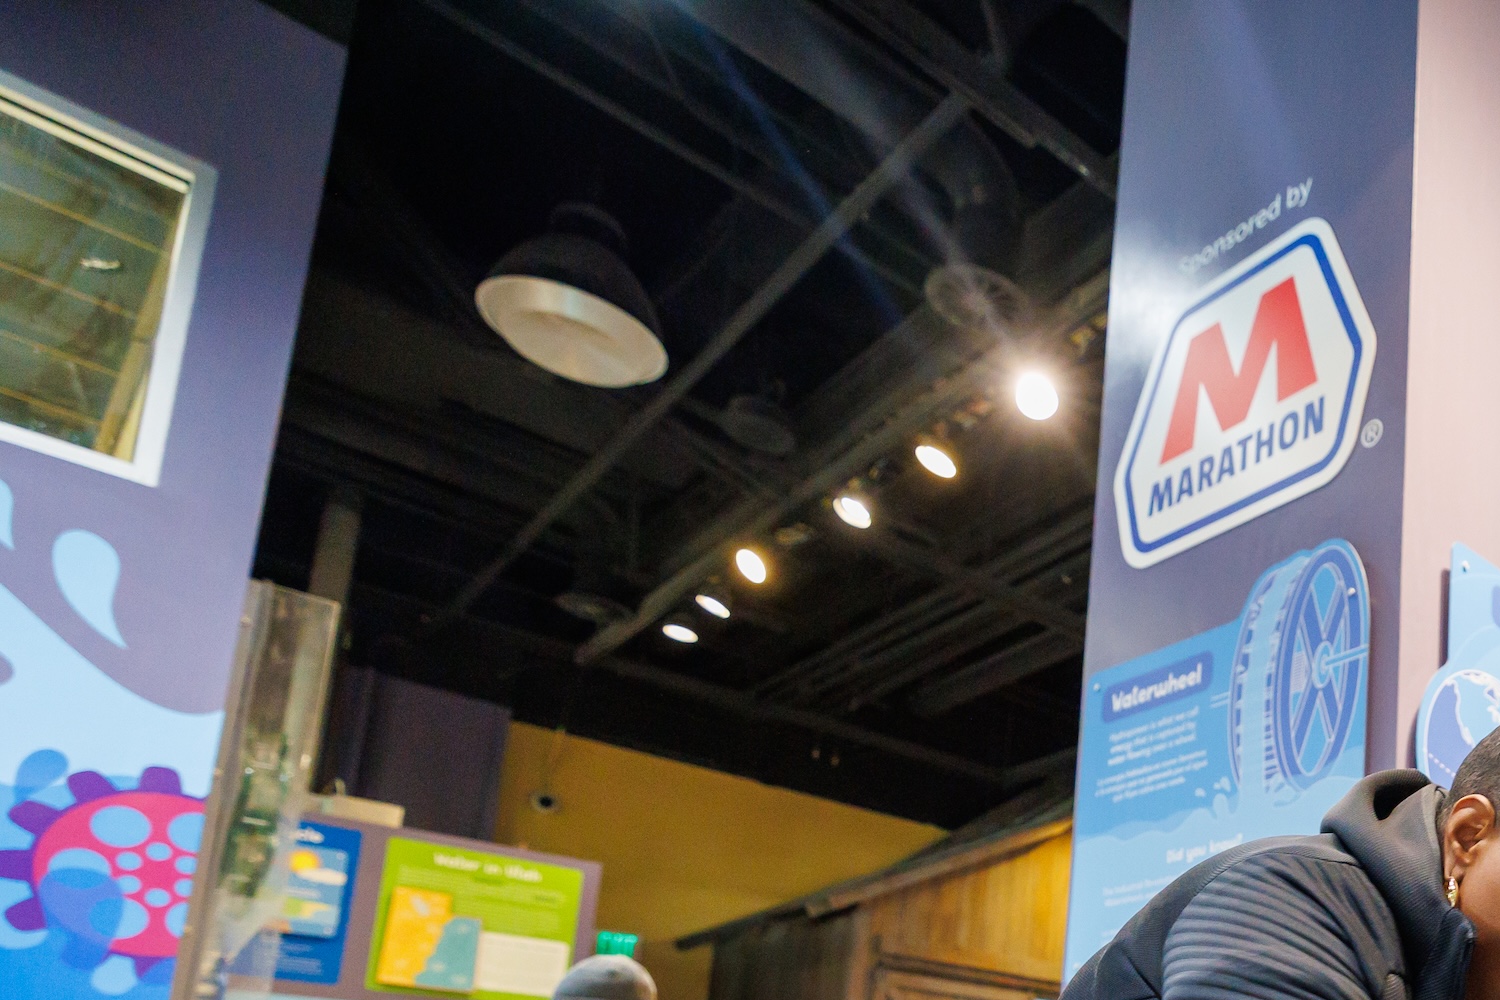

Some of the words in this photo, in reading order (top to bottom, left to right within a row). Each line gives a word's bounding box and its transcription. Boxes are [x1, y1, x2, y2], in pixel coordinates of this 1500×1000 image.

[1286, 177, 1313, 209] by
[1159, 275, 1318, 465] M
[1148, 395, 1326, 517] MARATHON
[1112, 662, 1202, 712] Waterwheel
